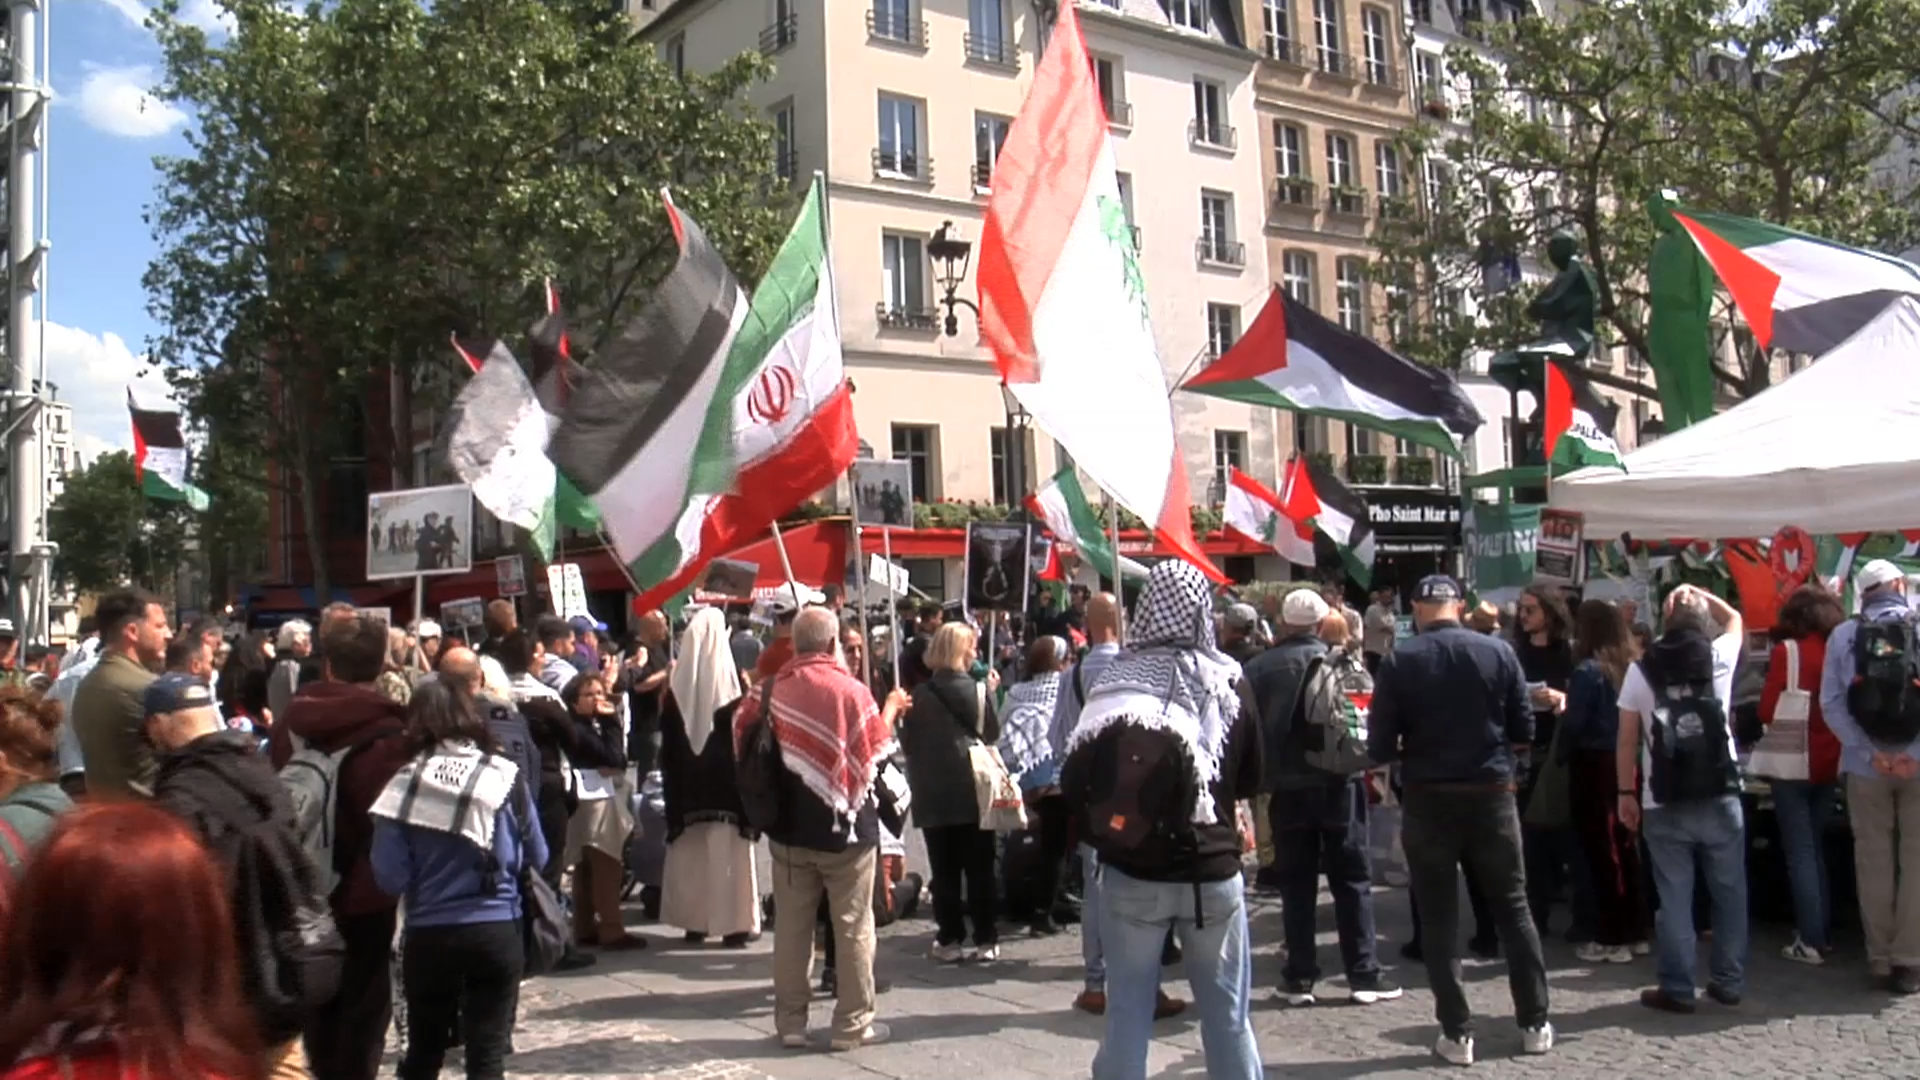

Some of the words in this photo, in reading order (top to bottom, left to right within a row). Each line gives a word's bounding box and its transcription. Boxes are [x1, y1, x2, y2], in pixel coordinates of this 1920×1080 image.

[1368, 504, 1391, 522] Pho
[1392, 504, 1421, 522] Saint
[1424, 505, 1460, 522] Marin
